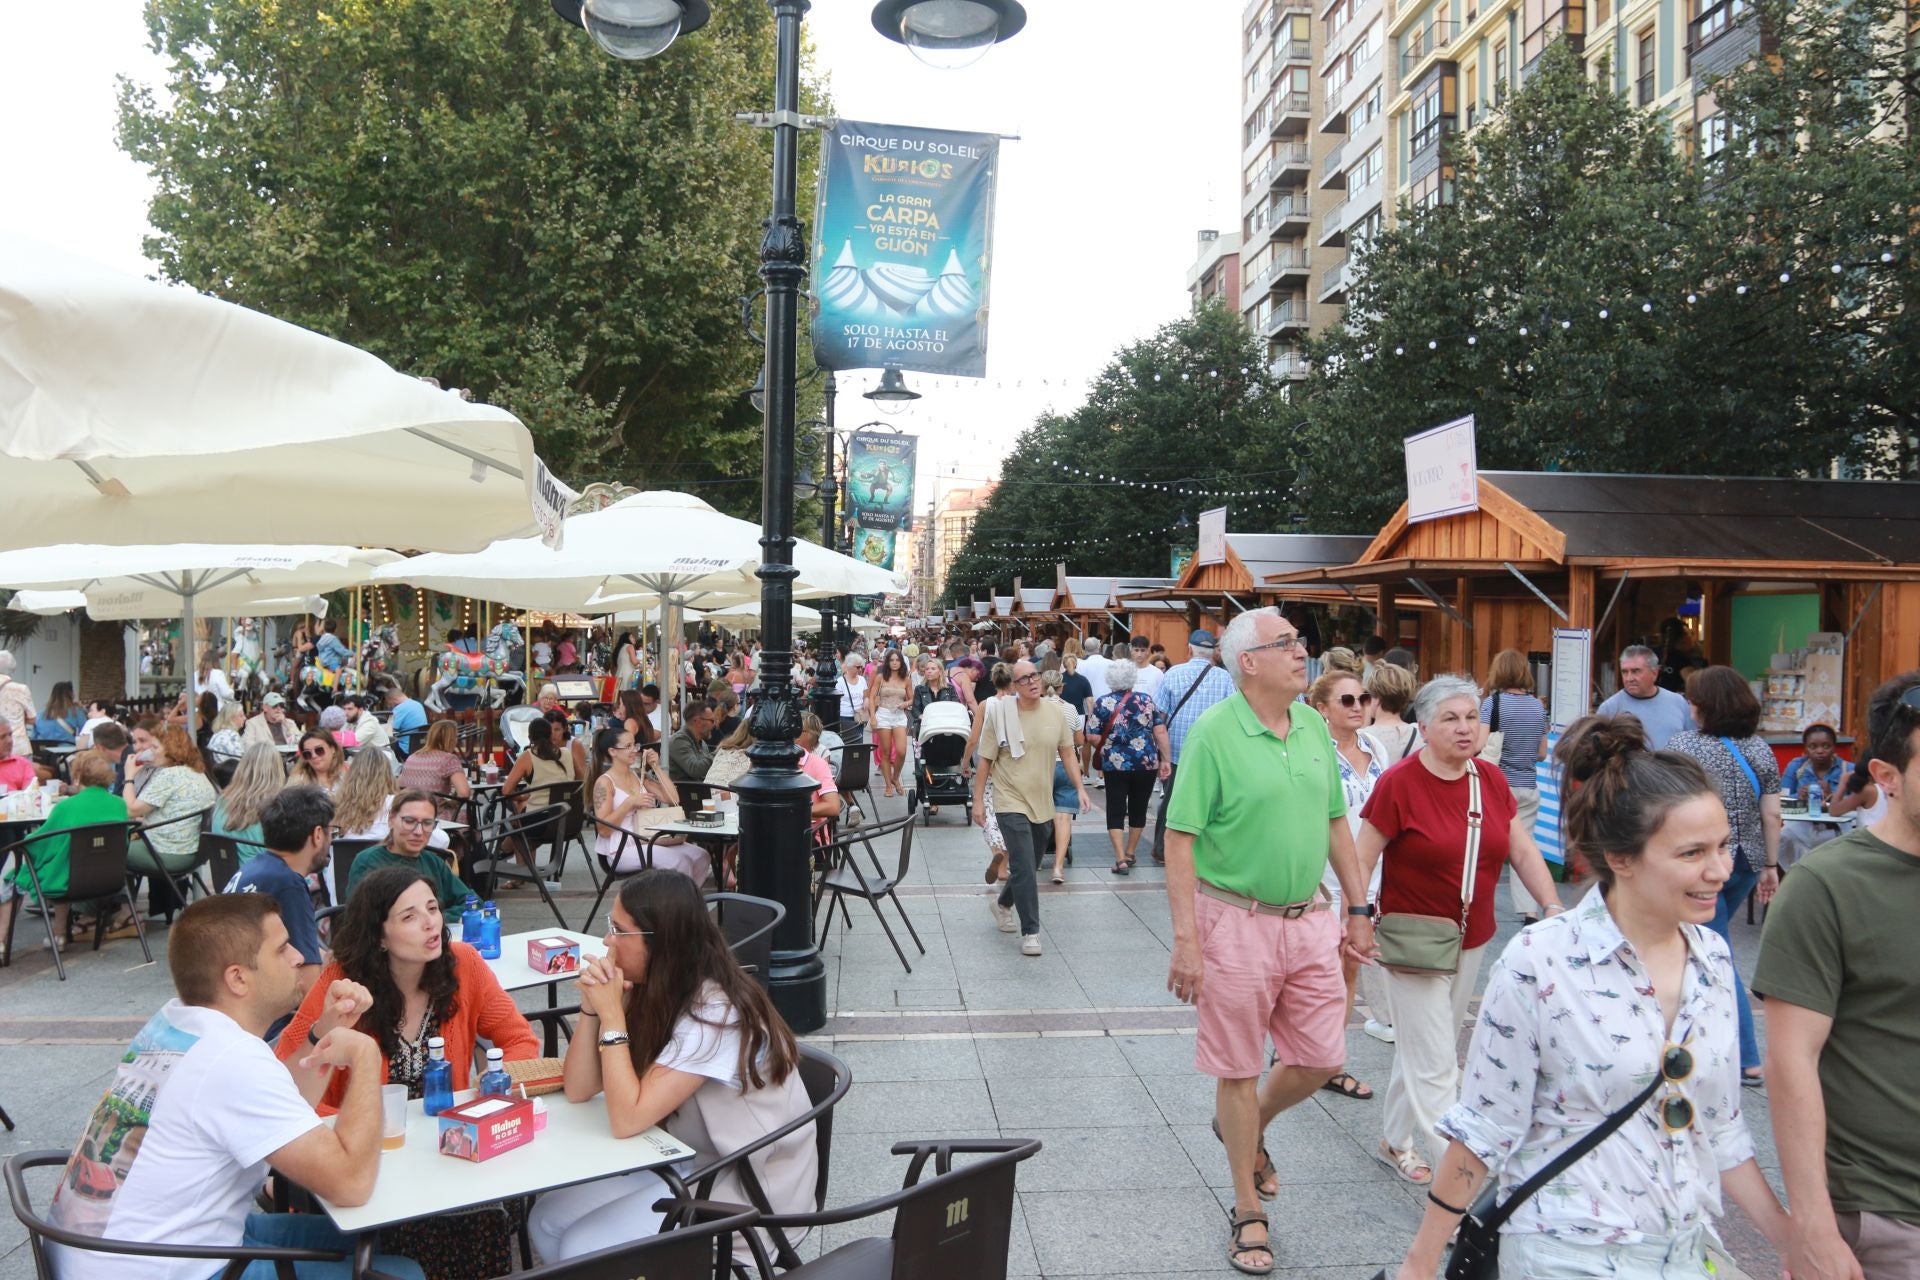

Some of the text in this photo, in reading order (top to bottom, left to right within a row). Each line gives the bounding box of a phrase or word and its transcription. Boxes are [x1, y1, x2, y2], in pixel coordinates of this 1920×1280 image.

[840, 134, 980, 160] CIRQUE DU SOLEIL
[879, 193, 932, 208] LA GRAN
[866, 204, 940, 230] CARPA
[869, 223, 886, 234] YA
[920, 230, 936, 242] EN
[843, 324, 949, 342] SOLO HASTA EL
[847, 336, 945, 353] 17 DE AGOSTO
[491, 1117, 522, 1136] Mahou
